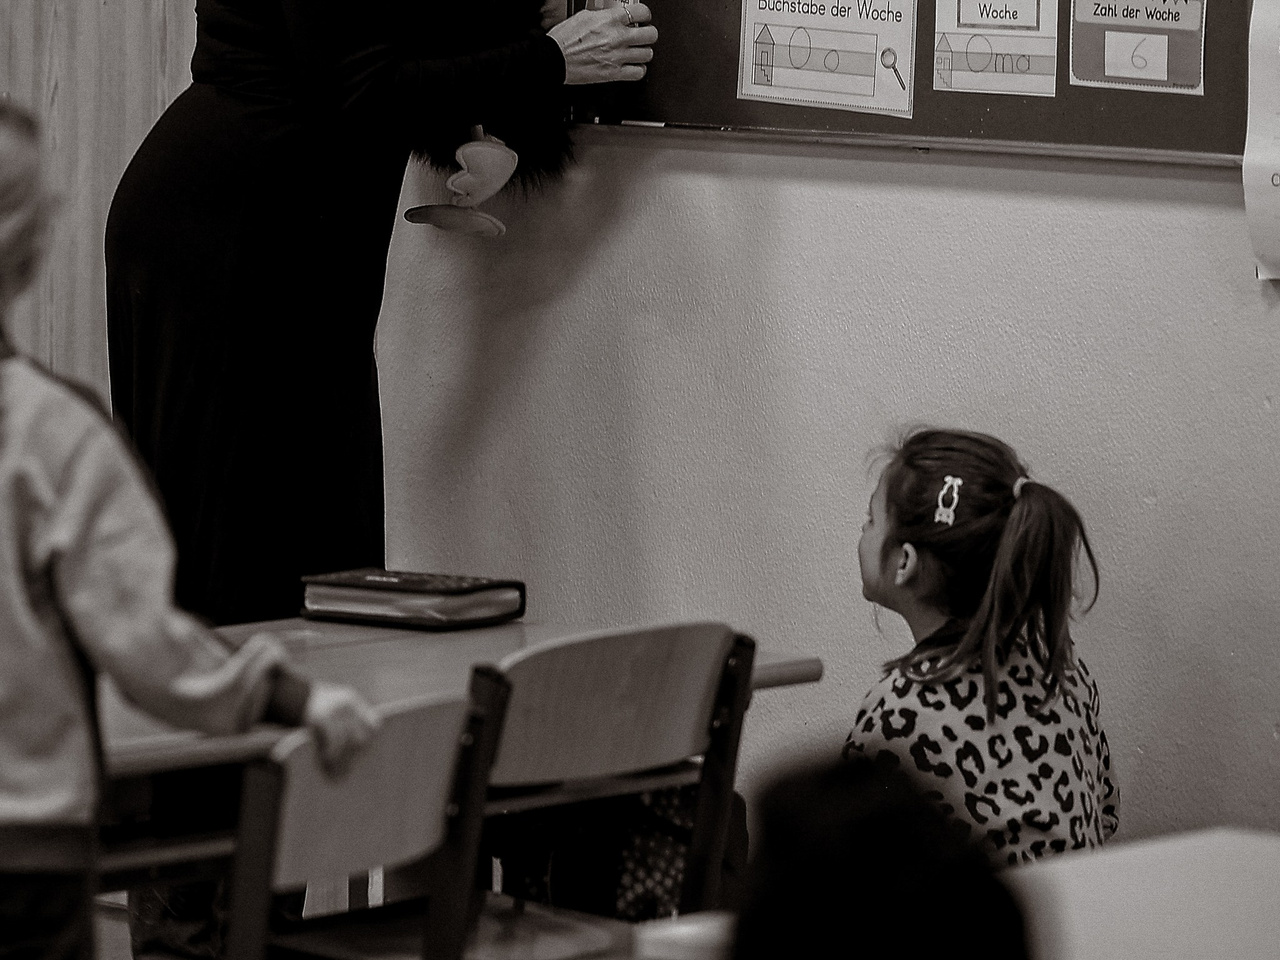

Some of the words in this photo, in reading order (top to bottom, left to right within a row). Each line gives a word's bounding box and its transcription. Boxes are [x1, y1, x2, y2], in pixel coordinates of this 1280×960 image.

[978, 3, 1018, 20] Woche
[1093, 2, 1118, 18] Zahl
[1122, 5, 1140, 19] der
[1145, 6, 1180, 22] Woche
[965, 34, 1031, 74] Oma
[1131, 37, 1148, 70] 6
